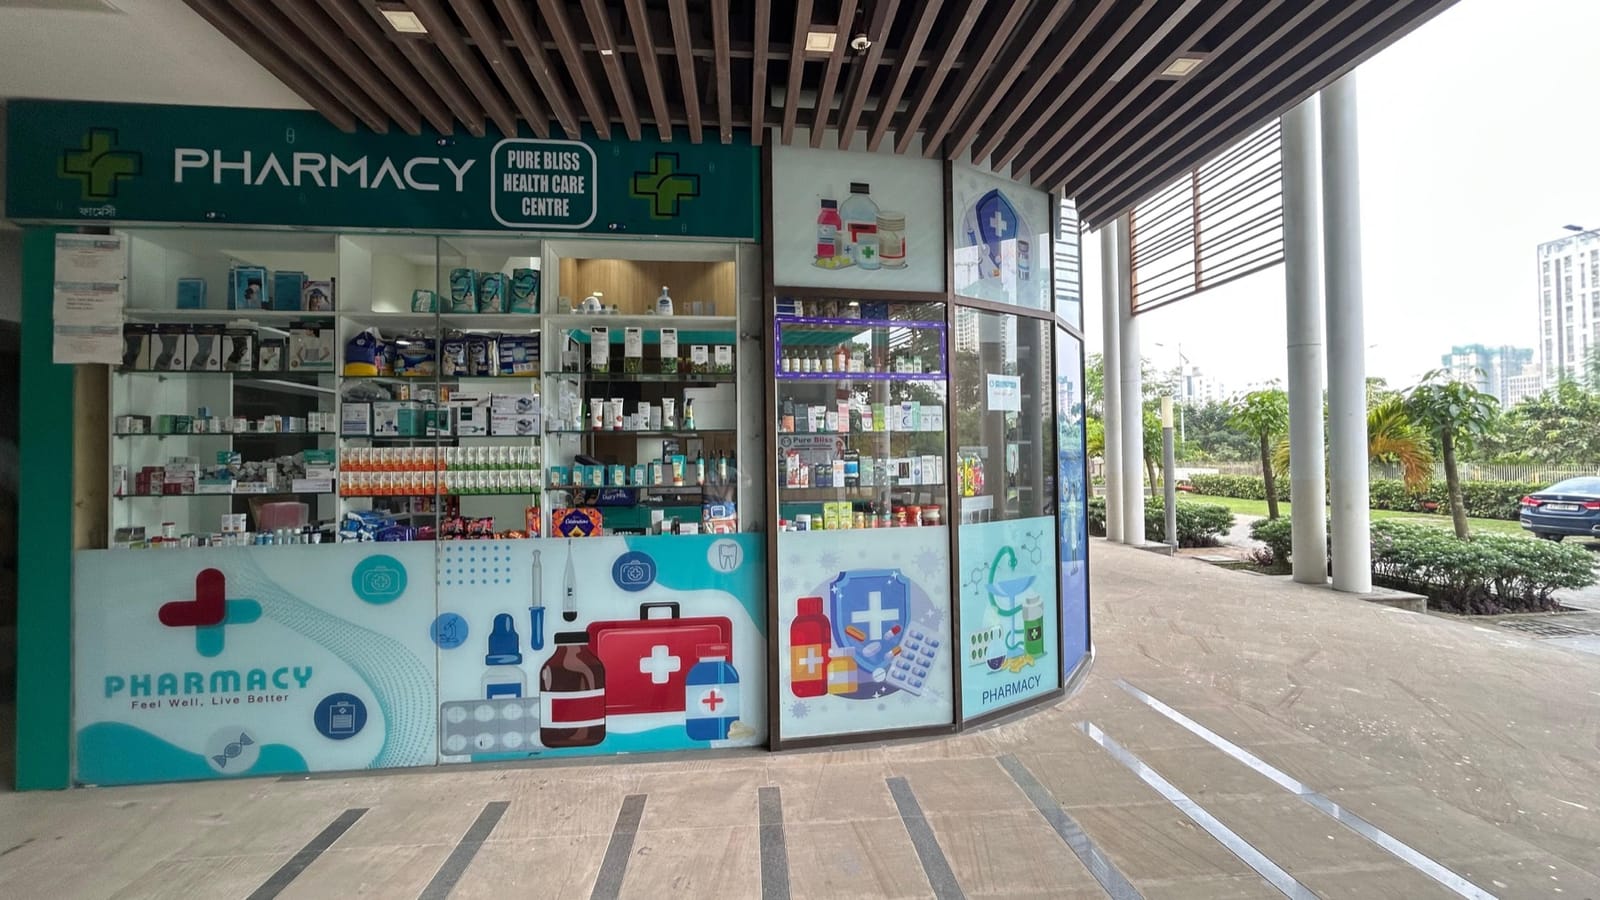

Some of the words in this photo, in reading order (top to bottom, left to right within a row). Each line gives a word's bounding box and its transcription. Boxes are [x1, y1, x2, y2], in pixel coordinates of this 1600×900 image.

[175, 148, 475, 192] PHARMACY
[507, 149, 541, 170] PURE
[543, 152, 581, 171] BLISS
[503, 173, 549, 194] HEALTH
[552, 175, 585, 195] CARE
[521, 197, 569, 217] CENTRE
[104, 666, 313, 698] PHARMACY
[982, 674, 1041, 704] PHARMACY
[131, 700, 161, 710] Feel
[211, 696, 240, 706] Live
[247, 694, 289, 703] Better
